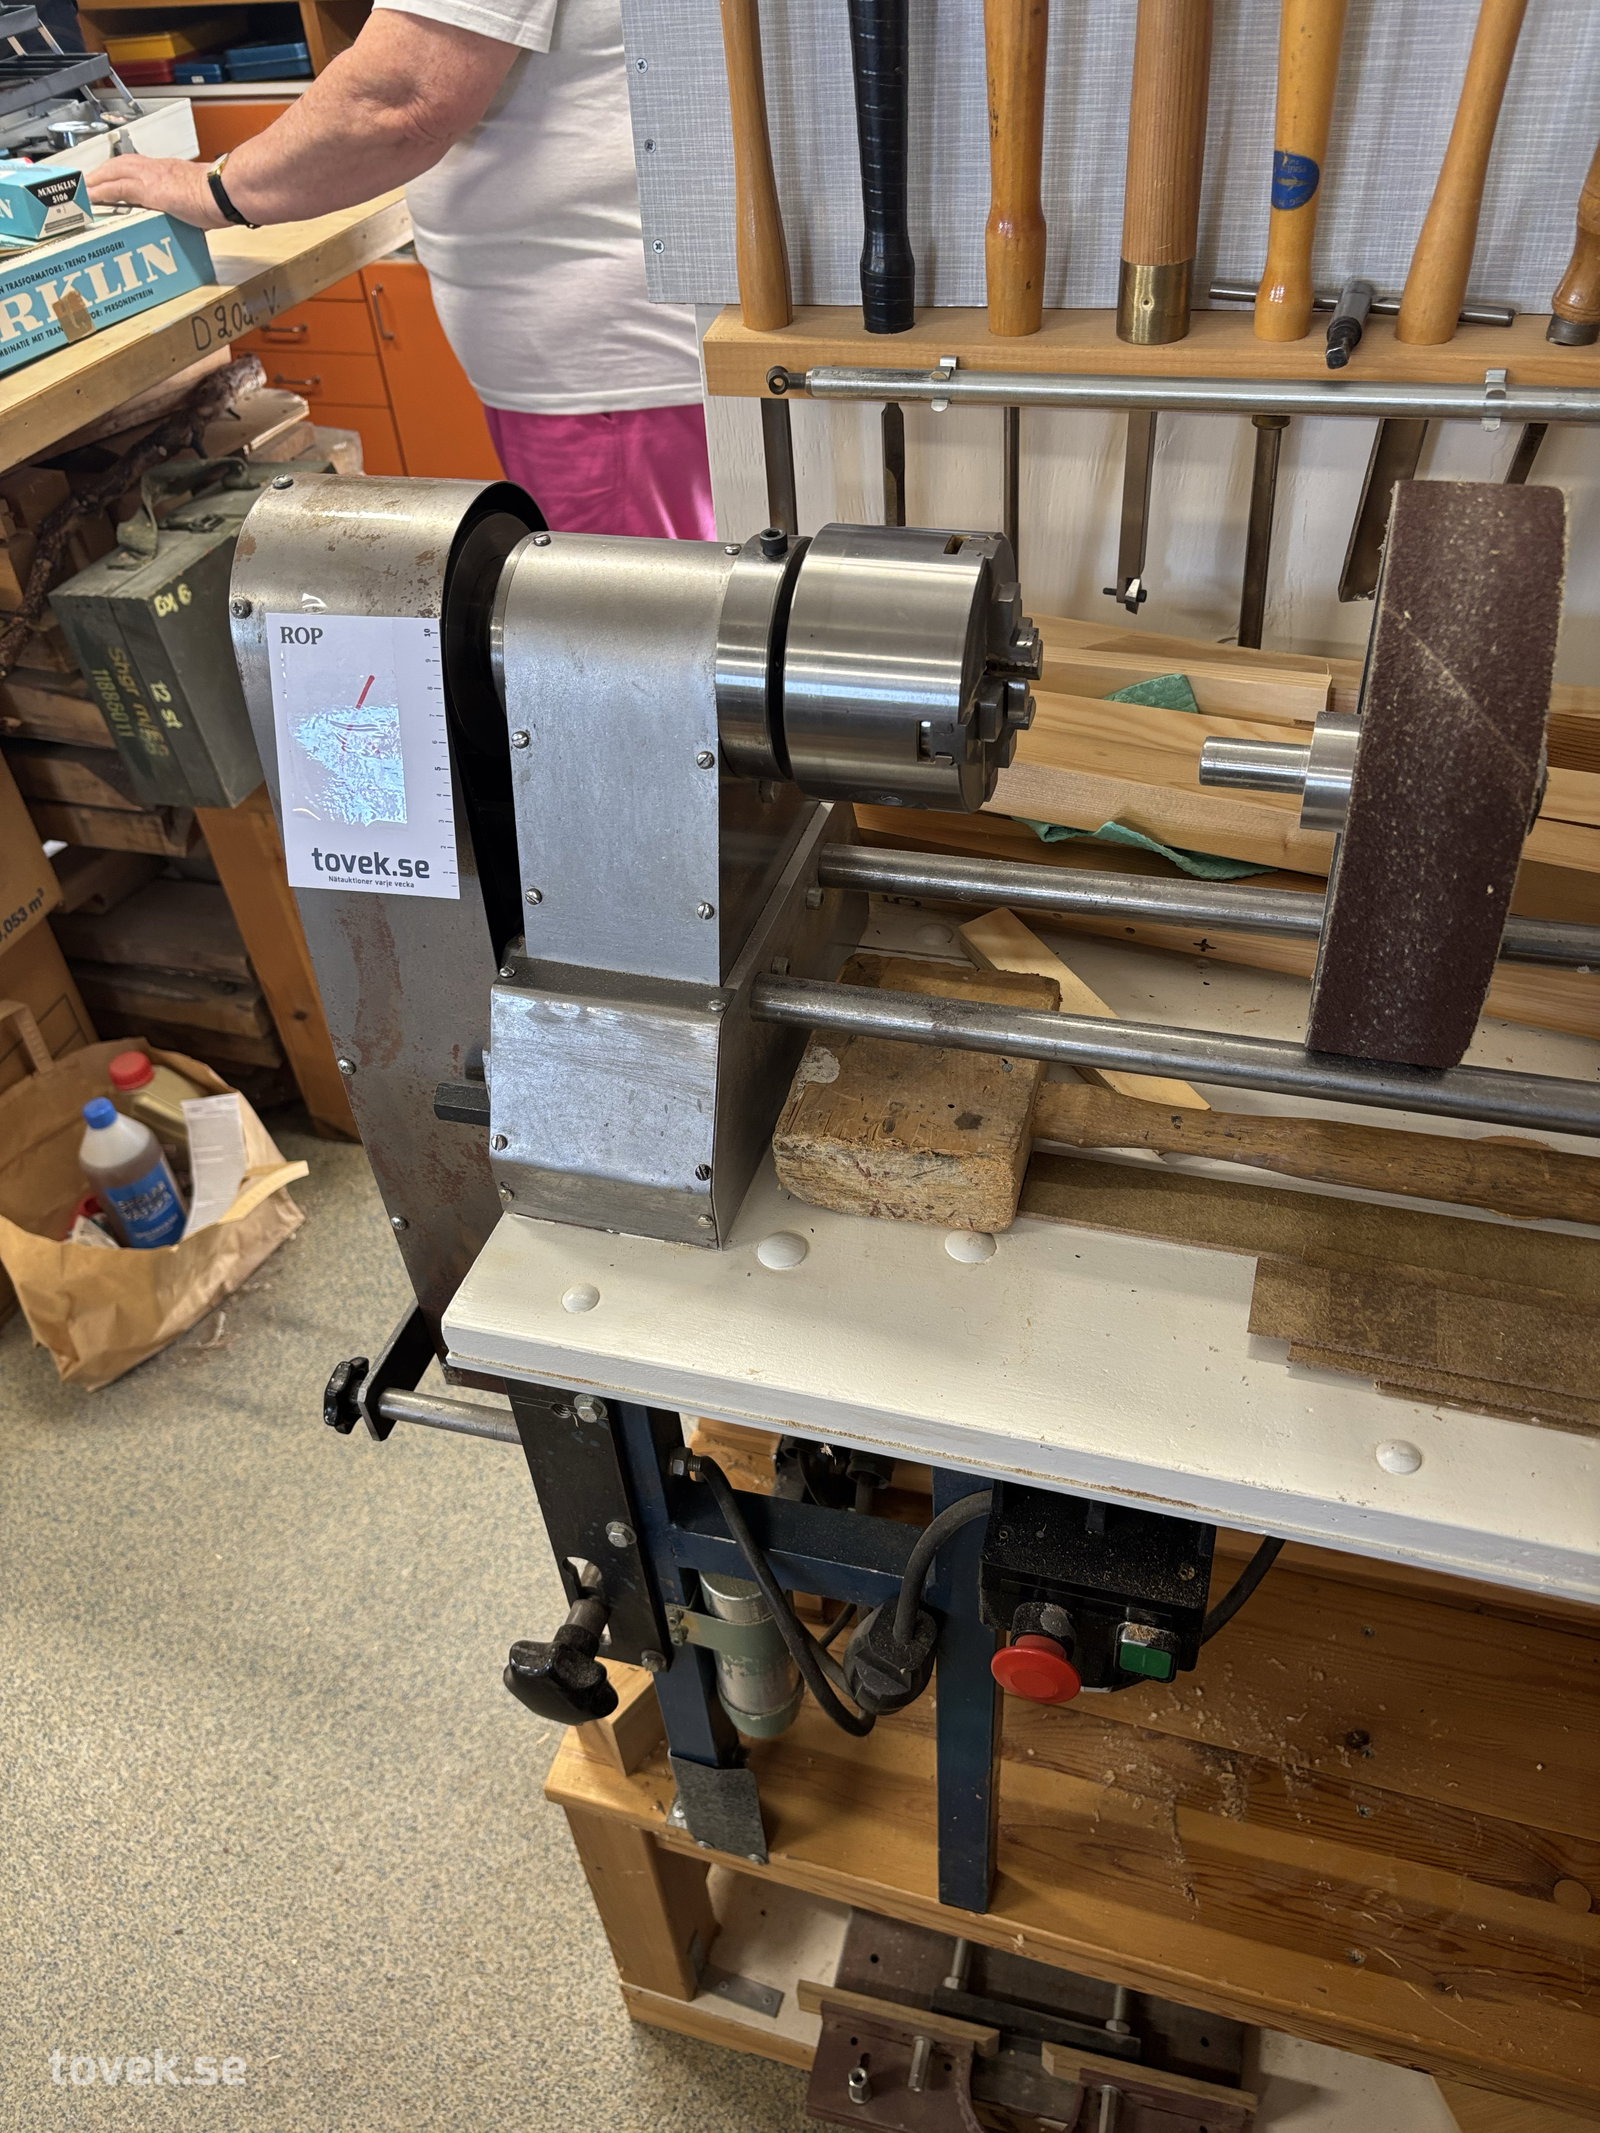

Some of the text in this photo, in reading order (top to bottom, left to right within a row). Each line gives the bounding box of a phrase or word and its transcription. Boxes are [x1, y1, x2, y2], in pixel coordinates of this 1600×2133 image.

[64, 255, 87, 270] TRENO
[88, 241, 125, 261] PASSEGGERI
[31, 332, 45, 344] MET
[104, 288, 154, 313] PERSONENTREIN
[177, 583, 192, 606] 6
[280, 626, 324, 645] ROP
[424, 628, 431, 637] 10
[150, 680, 172, 703] 12
[311, 847, 430, 879] tovek.se
[328, 875, 373, 885] Nätauktioner
[375, 880, 393, 888] varje
[0, 906, 28, 942] ,053
